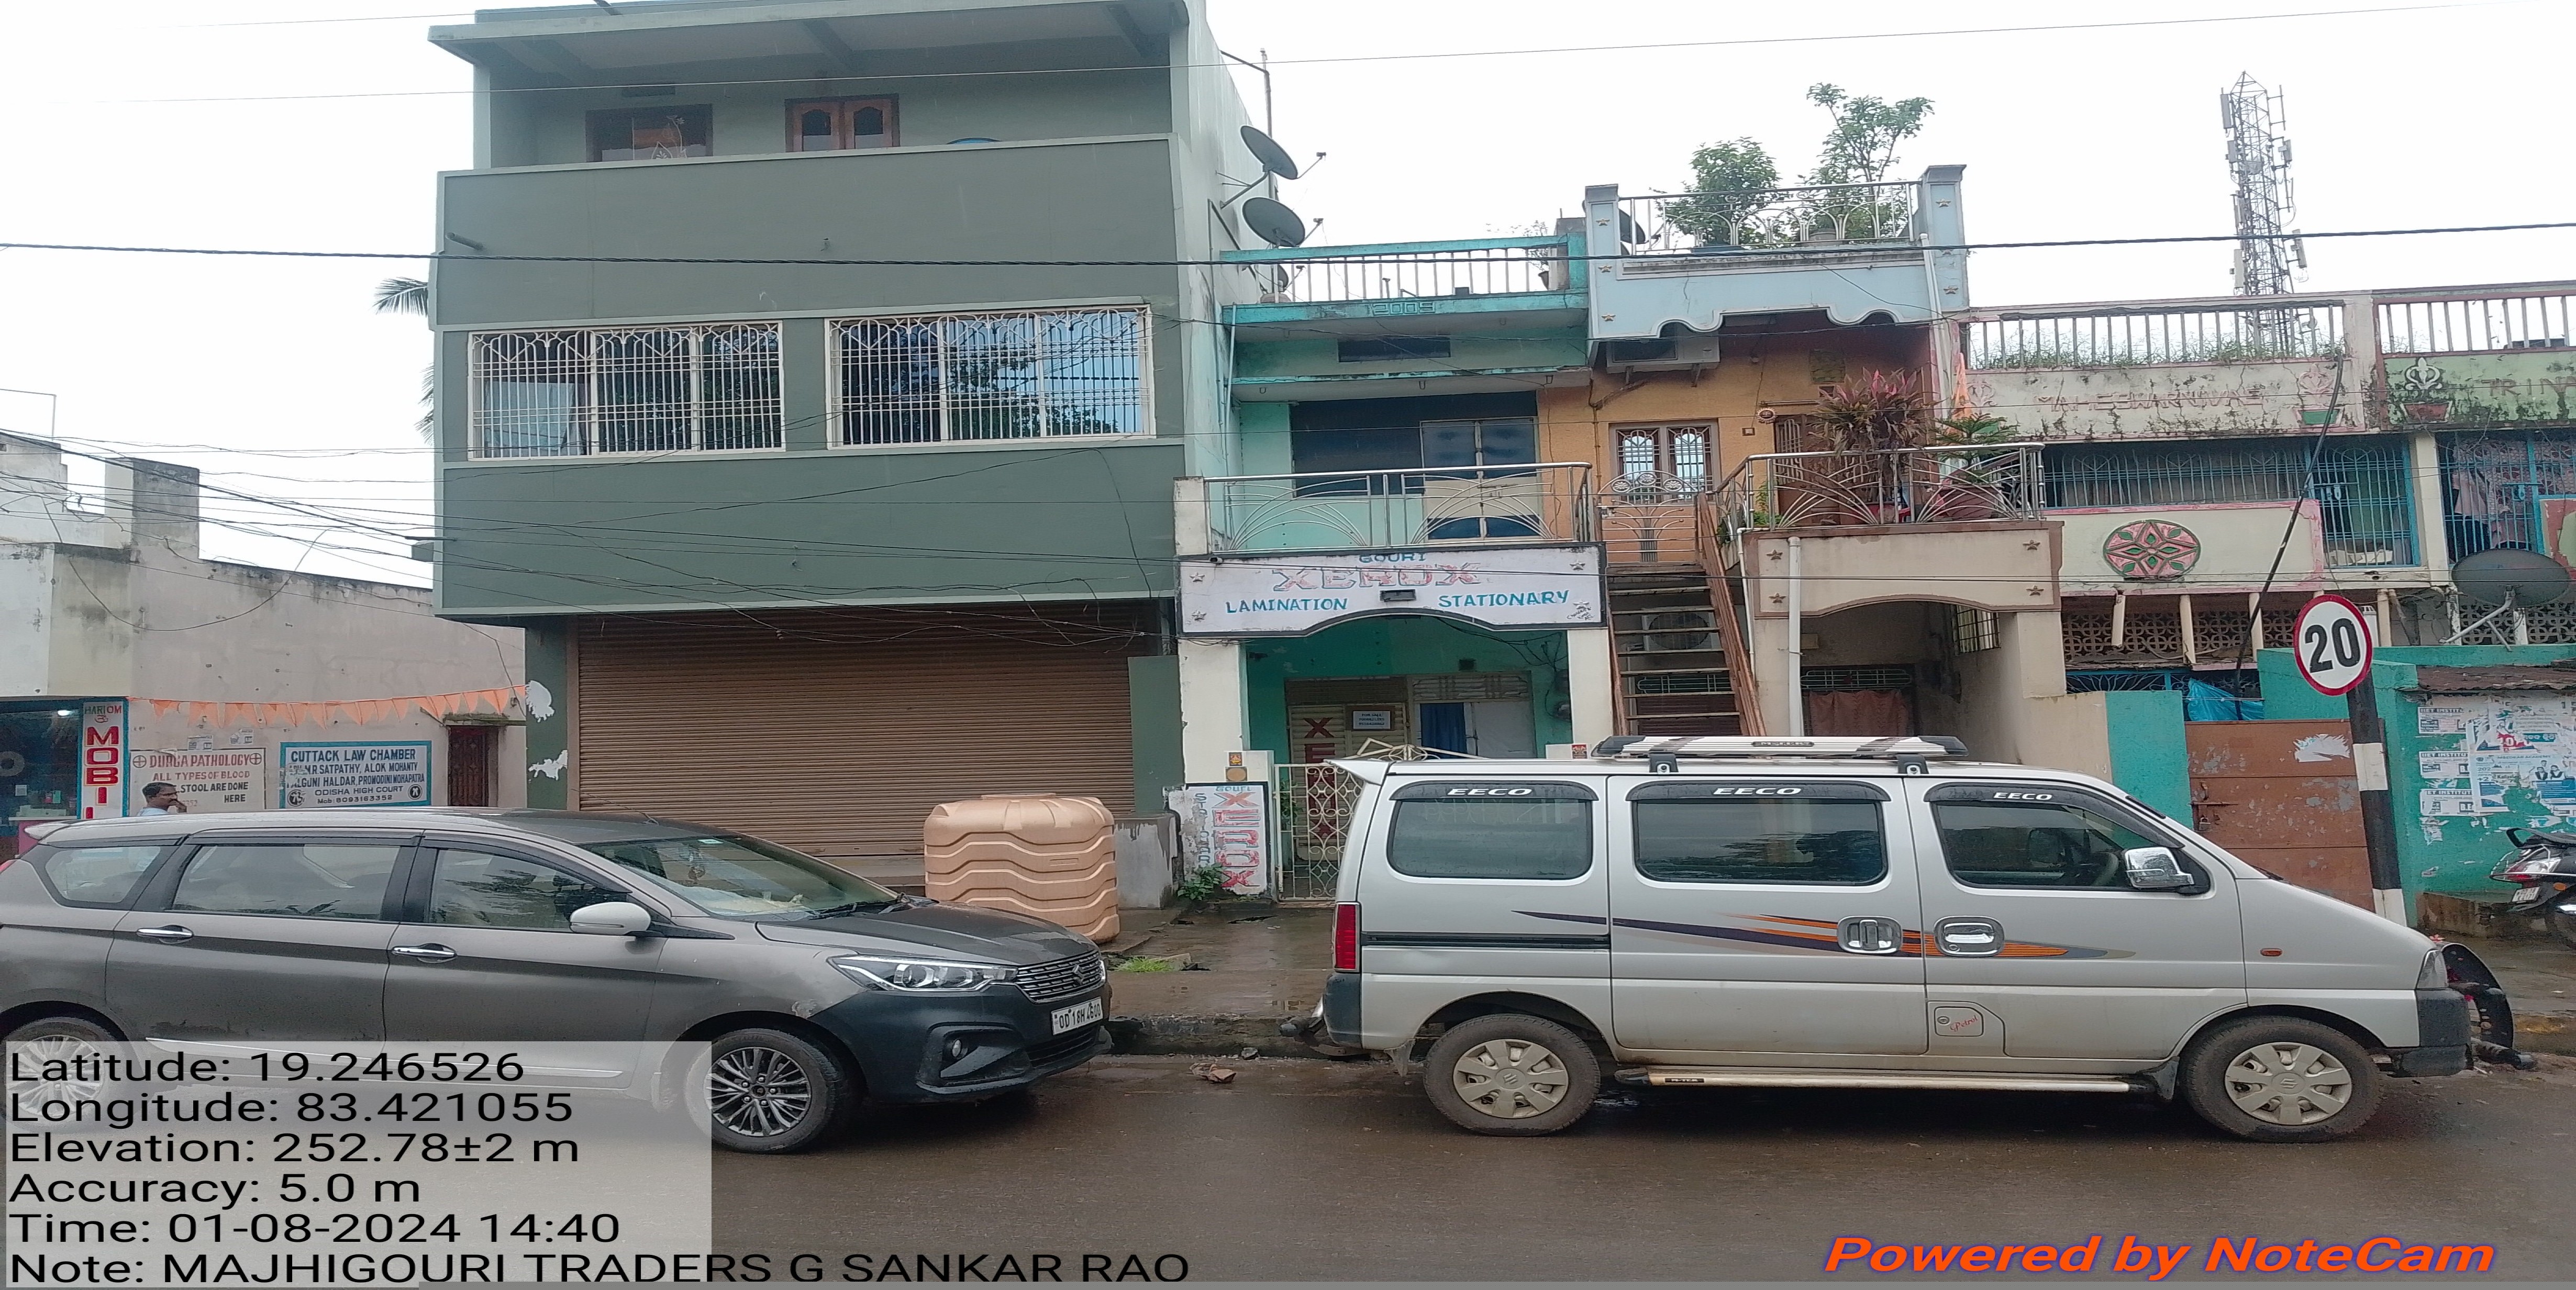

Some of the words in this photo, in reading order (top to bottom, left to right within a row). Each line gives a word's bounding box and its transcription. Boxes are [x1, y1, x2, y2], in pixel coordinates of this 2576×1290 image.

[1372, 302, 1436, 316] 2009
[1272, 562, 1481, 591] XEROX
[1226, 597, 1348, 614] LAMINATION
[1438, 590, 1570, 607] STATIONARY
[2305, 618, 2361, 673] 20
[84, 705, 105, 714] HARI
[106, 705, 121, 714] OM
[191, 753, 250, 767] PATHOLOGY
[291, 750, 339, 762] CUTTACK
[344, 749, 367, 761] LAW
[370, 749, 416, 761] CHAMBER
[364, 763, 386, 773] ALOK
[388, 762, 418, 772] MOHANTY
[152, 772, 172, 782] ALL
[175, 771, 207, 781] TYPES
[207, 771, 219, 780] OF
[221, 770, 250, 779] BLOOD
[180, 784, 209, 793] STOOL
[210, 783, 227, 792] ARE
[227, 782, 249, 791] DONE
[224, 794, 246, 803] HERE
[1993, 792, 2052, 800] EECO
[1950, 1015, 1978, 1032] Petrol
